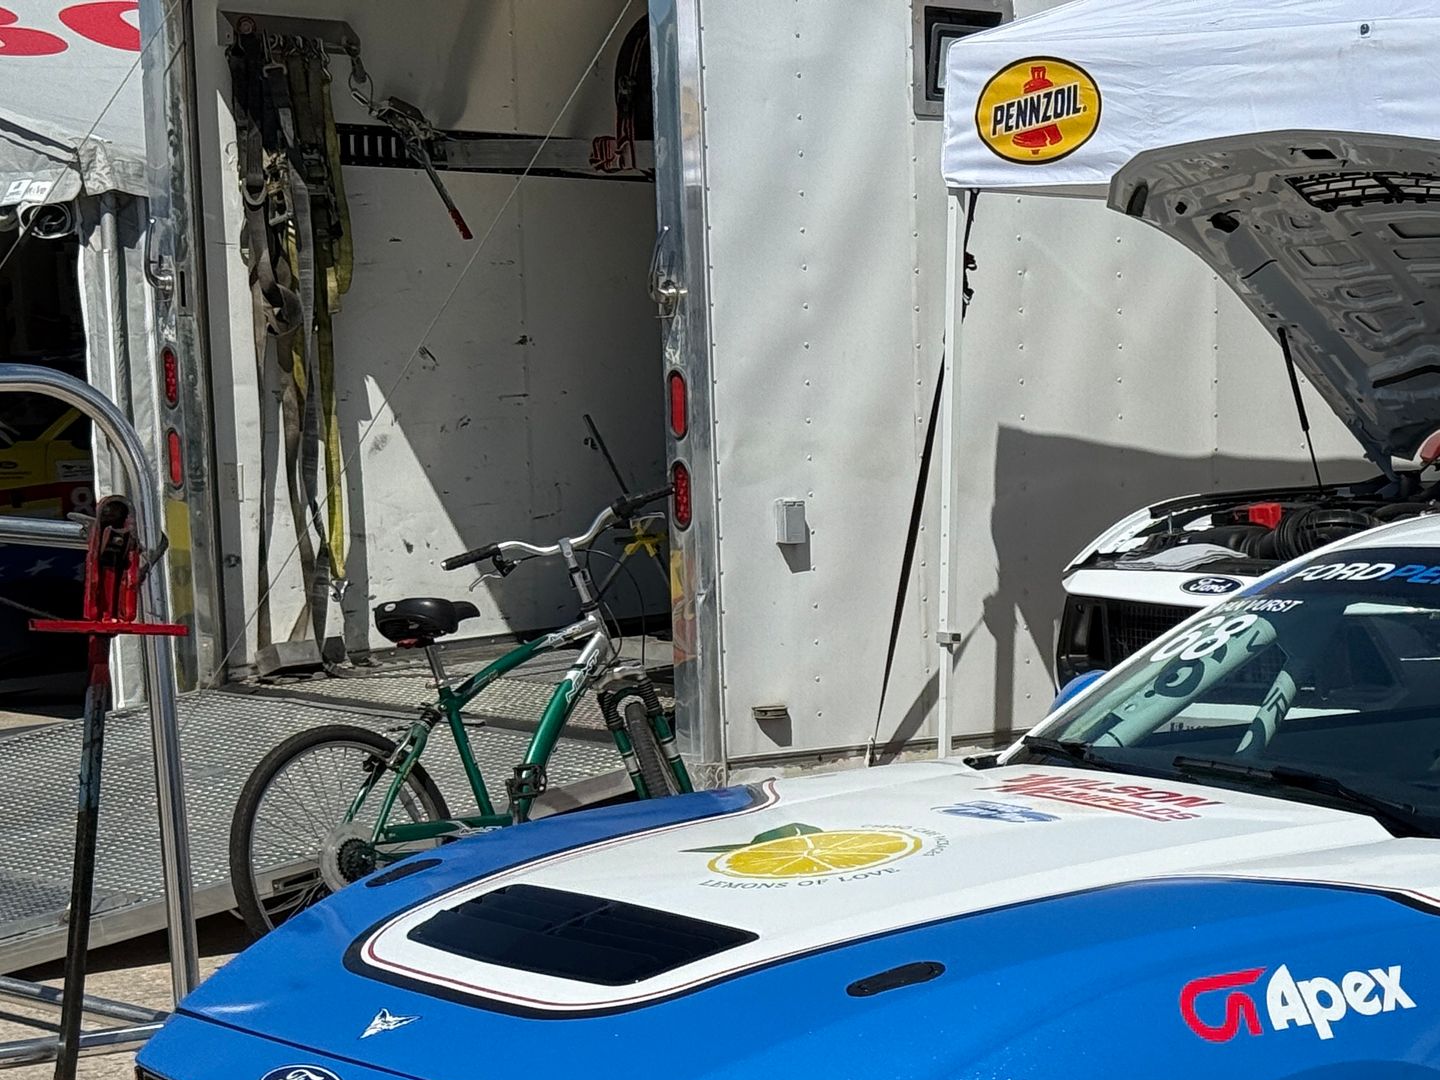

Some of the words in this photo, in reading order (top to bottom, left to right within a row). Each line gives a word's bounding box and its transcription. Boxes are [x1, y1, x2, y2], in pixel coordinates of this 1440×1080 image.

[991, 84, 1083, 137] PENNZOIL
[1190, 578, 1231, 592] Ford
[1150, 613, 1258, 661] 68
[698, 870, 789, 890] LEMONS
[797, 877, 828, 887] OF
[839, 858, 898, 882] LOVE
[1266, 963, 1417, 1040] Apex
